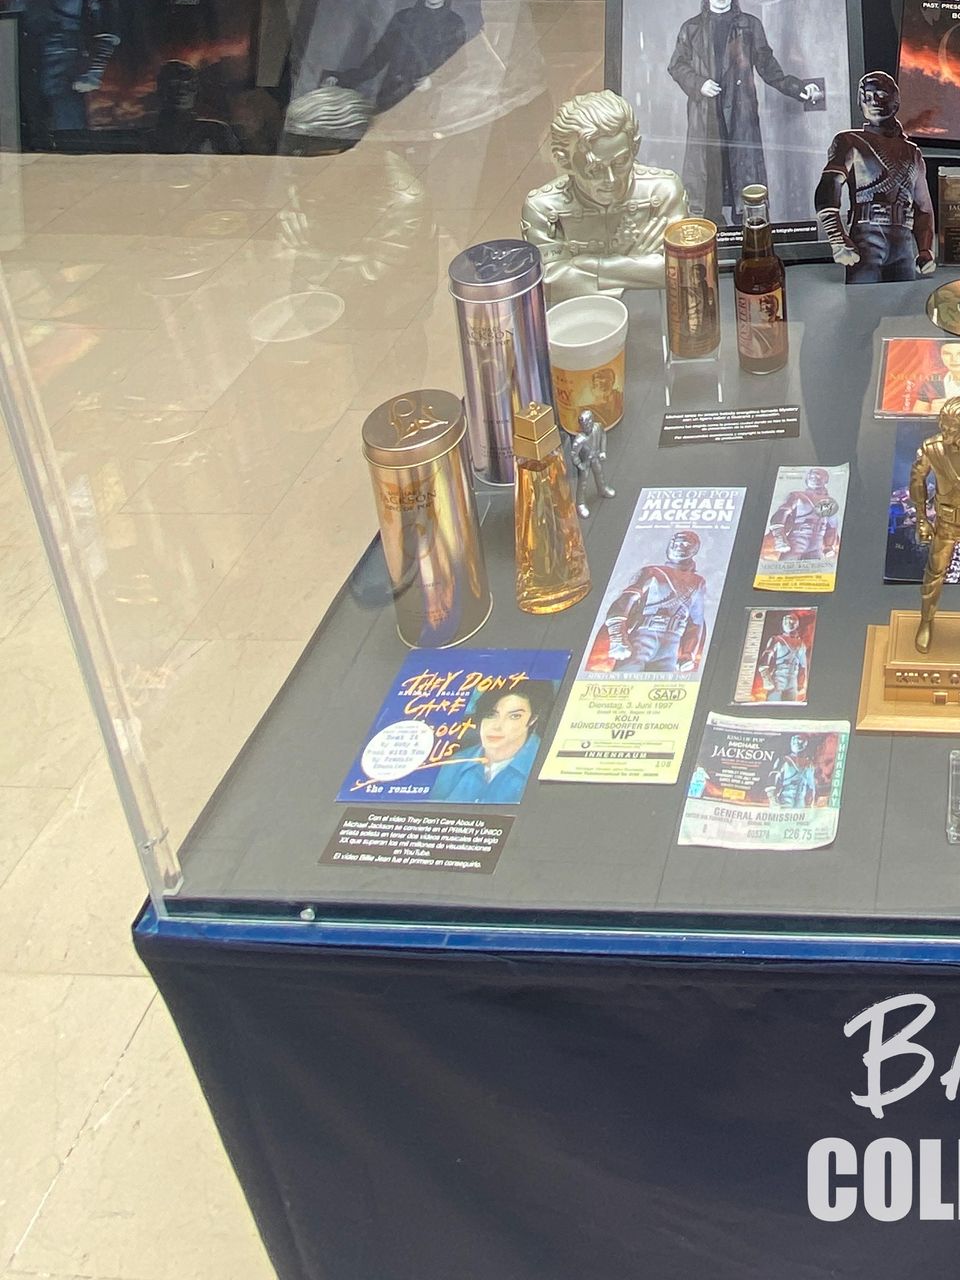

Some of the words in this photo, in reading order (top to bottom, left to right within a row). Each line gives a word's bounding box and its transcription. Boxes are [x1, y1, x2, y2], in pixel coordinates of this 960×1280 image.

[646, 490, 682, 499] KING
[686, 490, 706, 498] OF
[708, 490, 738, 499] POP
[642, 498, 735, 510] MICHAEL
[638, 510, 734, 522] JACKSON
[402, 670, 464, 692] THEY
[404, 696, 466, 717] CARE
[588, 701, 624, 710] Dienstag,
[614, 714, 639, 722] KÖLN
[570, 722, 643, 730] MÜNGERSDORFER
[611, 730, 635, 740] VIP
[728, 741, 760, 749] MICHAEL
[711, 745, 774, 761] JACKSON
[830, 734, 847, 806] THURSDAY
[366, 785, 384, 793] the
[388, 785, 431, 794] remixes
[714, 807, 752, 820] GENERAL
[756, 810, 805, 821] ADMISSION
[407, 816, 421, 825] They
[343, 820, 367, 829] Michael
[368, 822, 394, 830] Jackson
[403, 824, 431, 832] convierte
[448, 827, 473, 835] PRIMER
[362, 839, 388, 848] superan
[446, 844, 492, 852] visualizaciones
[441, 834, 472, 842] musicales
[483, 837, 499, 845] siglo
[375, 855, 391, 863] Jean
[410, 858, 434, 867] primero
